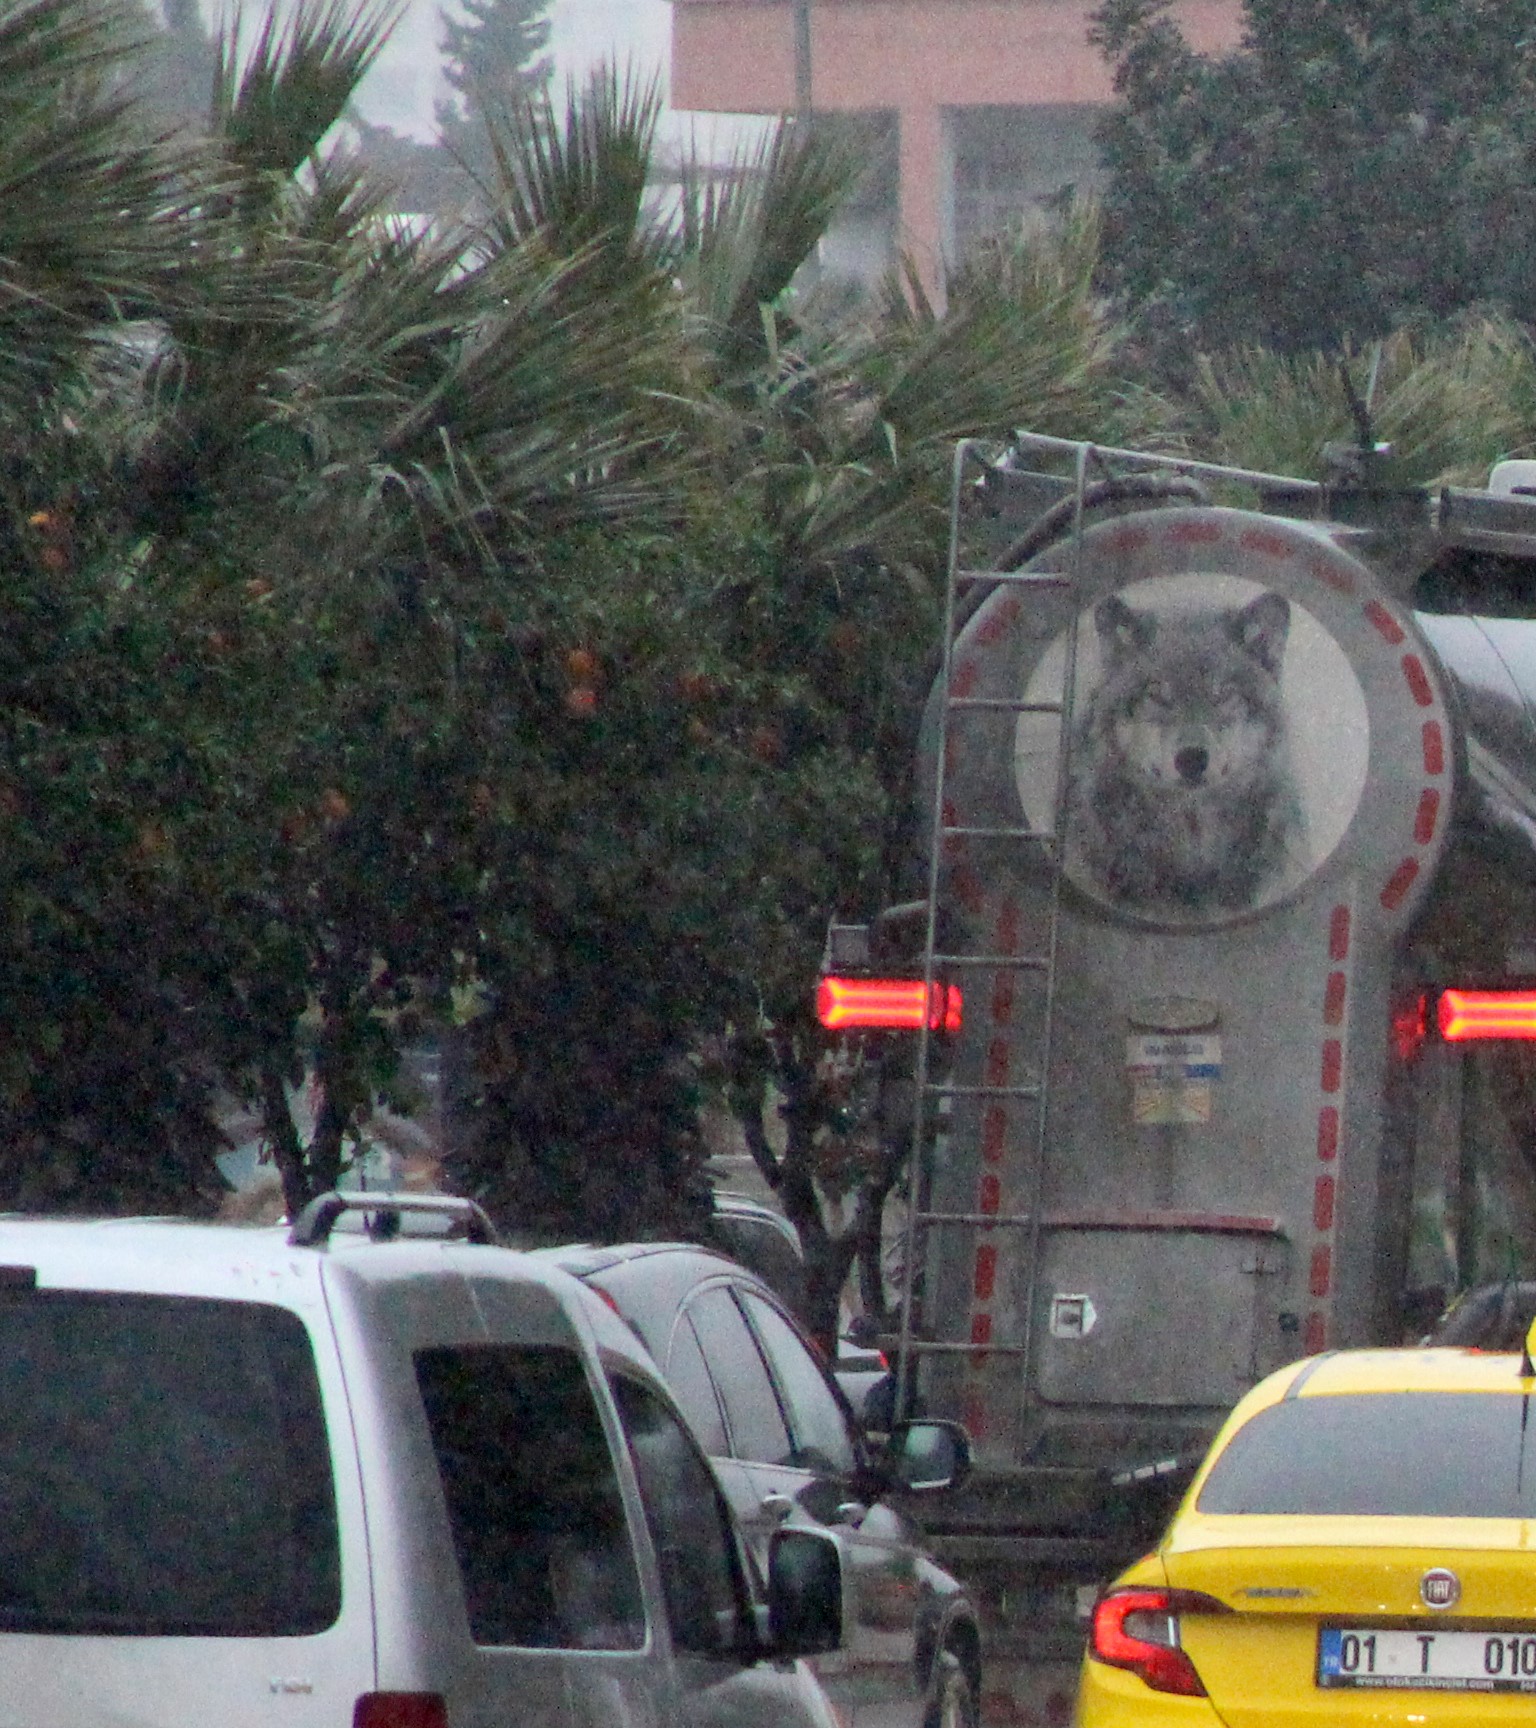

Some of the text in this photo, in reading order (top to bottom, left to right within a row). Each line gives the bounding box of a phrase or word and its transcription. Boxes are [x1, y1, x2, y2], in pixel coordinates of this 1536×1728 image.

[1427, 1579, 1450, 1600] FIAT
[1341, 1634, 1377, 1672] 01
[1416, 1634, 1436, 1674] T
